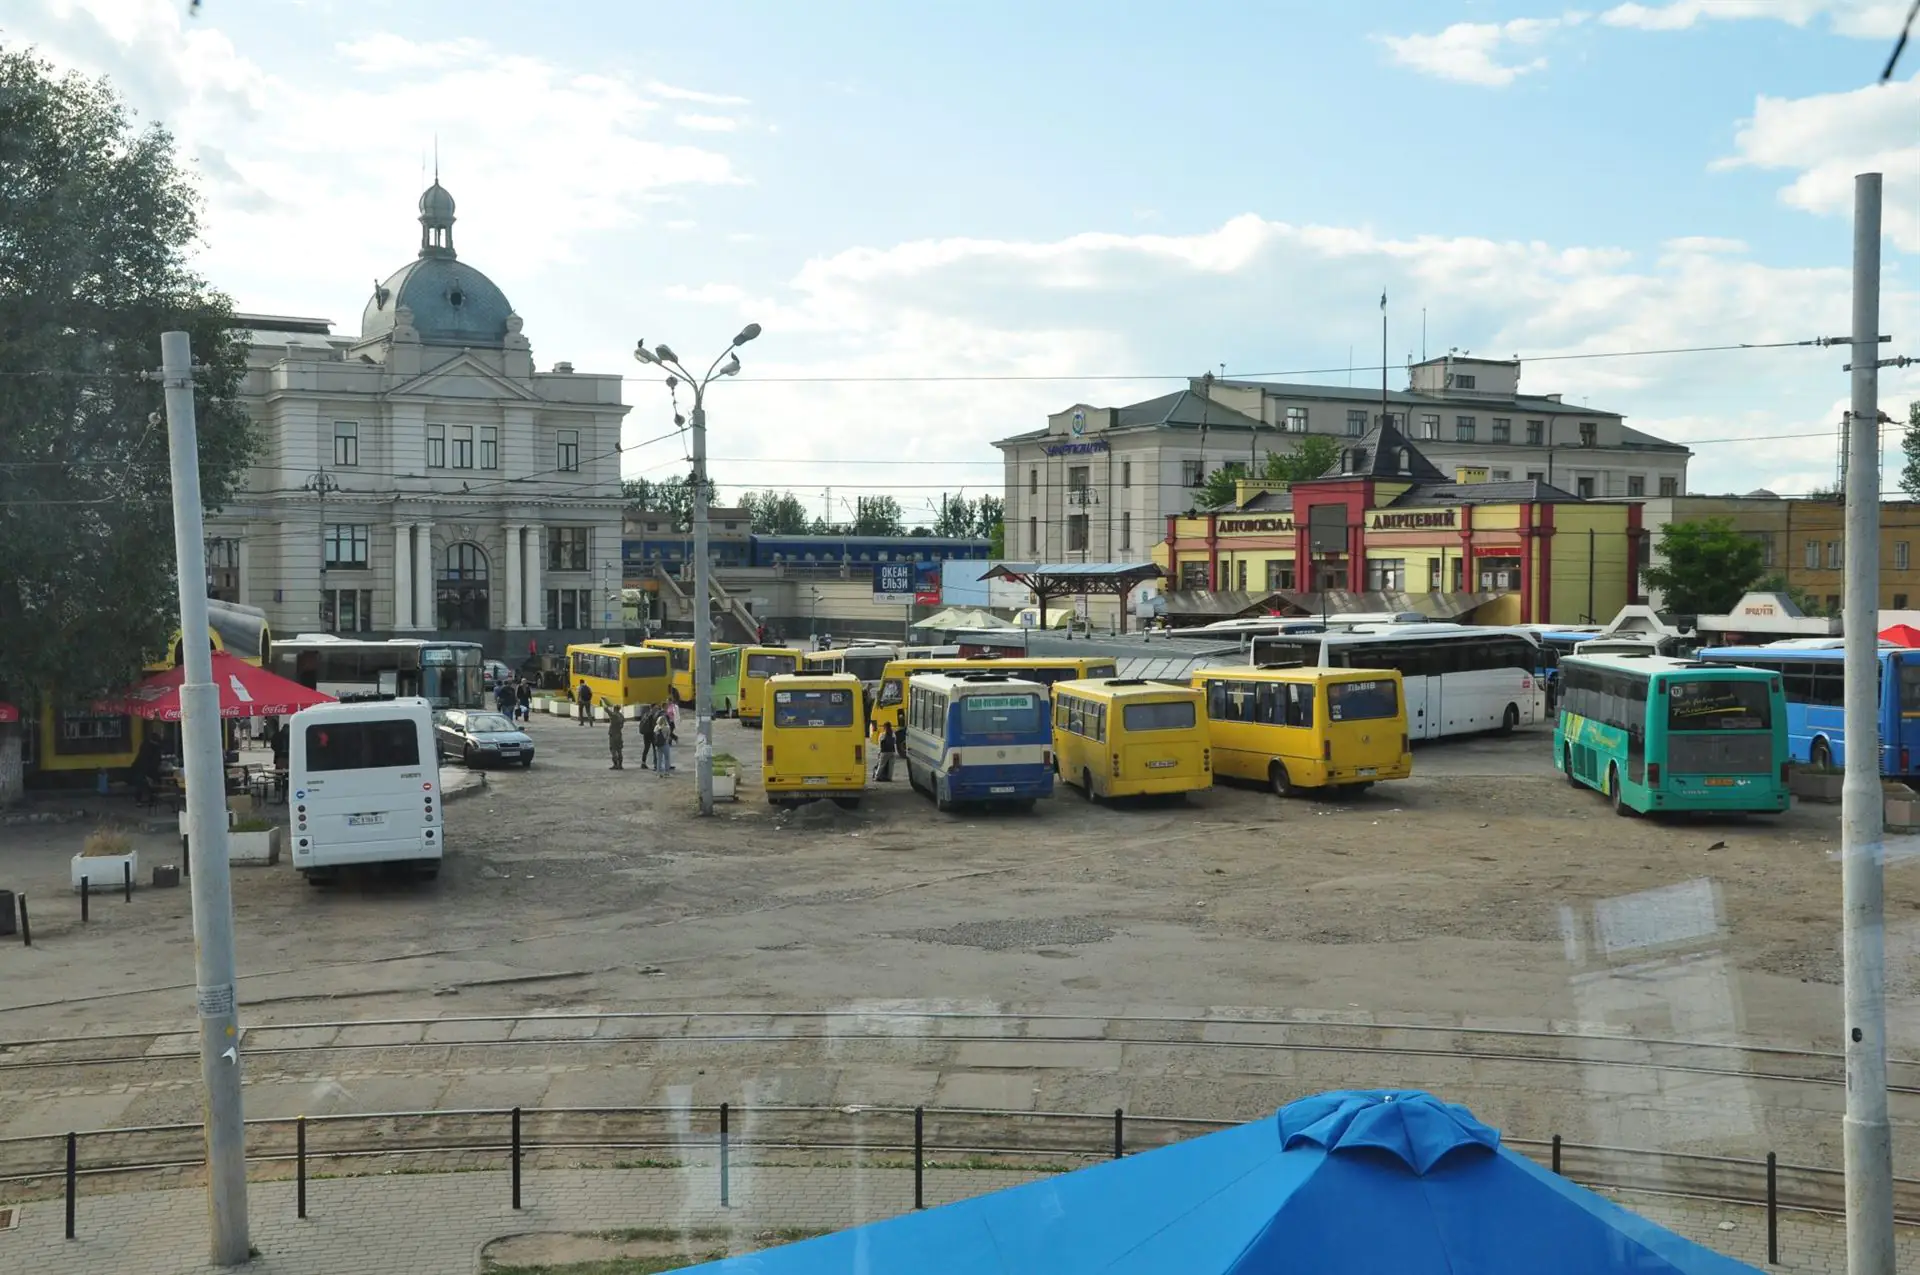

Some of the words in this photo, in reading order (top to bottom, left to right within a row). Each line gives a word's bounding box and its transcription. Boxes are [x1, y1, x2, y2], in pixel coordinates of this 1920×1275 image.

[1219, 518, 1294, 533] АВТОВОКЗАЛ
[1372, 509, 1456, 530] ДВІРЦЕВИЙ
[881, 566, 908, 578] ОКЕАН
[881, 578, 908, 590] ЕЛЬЗИ
